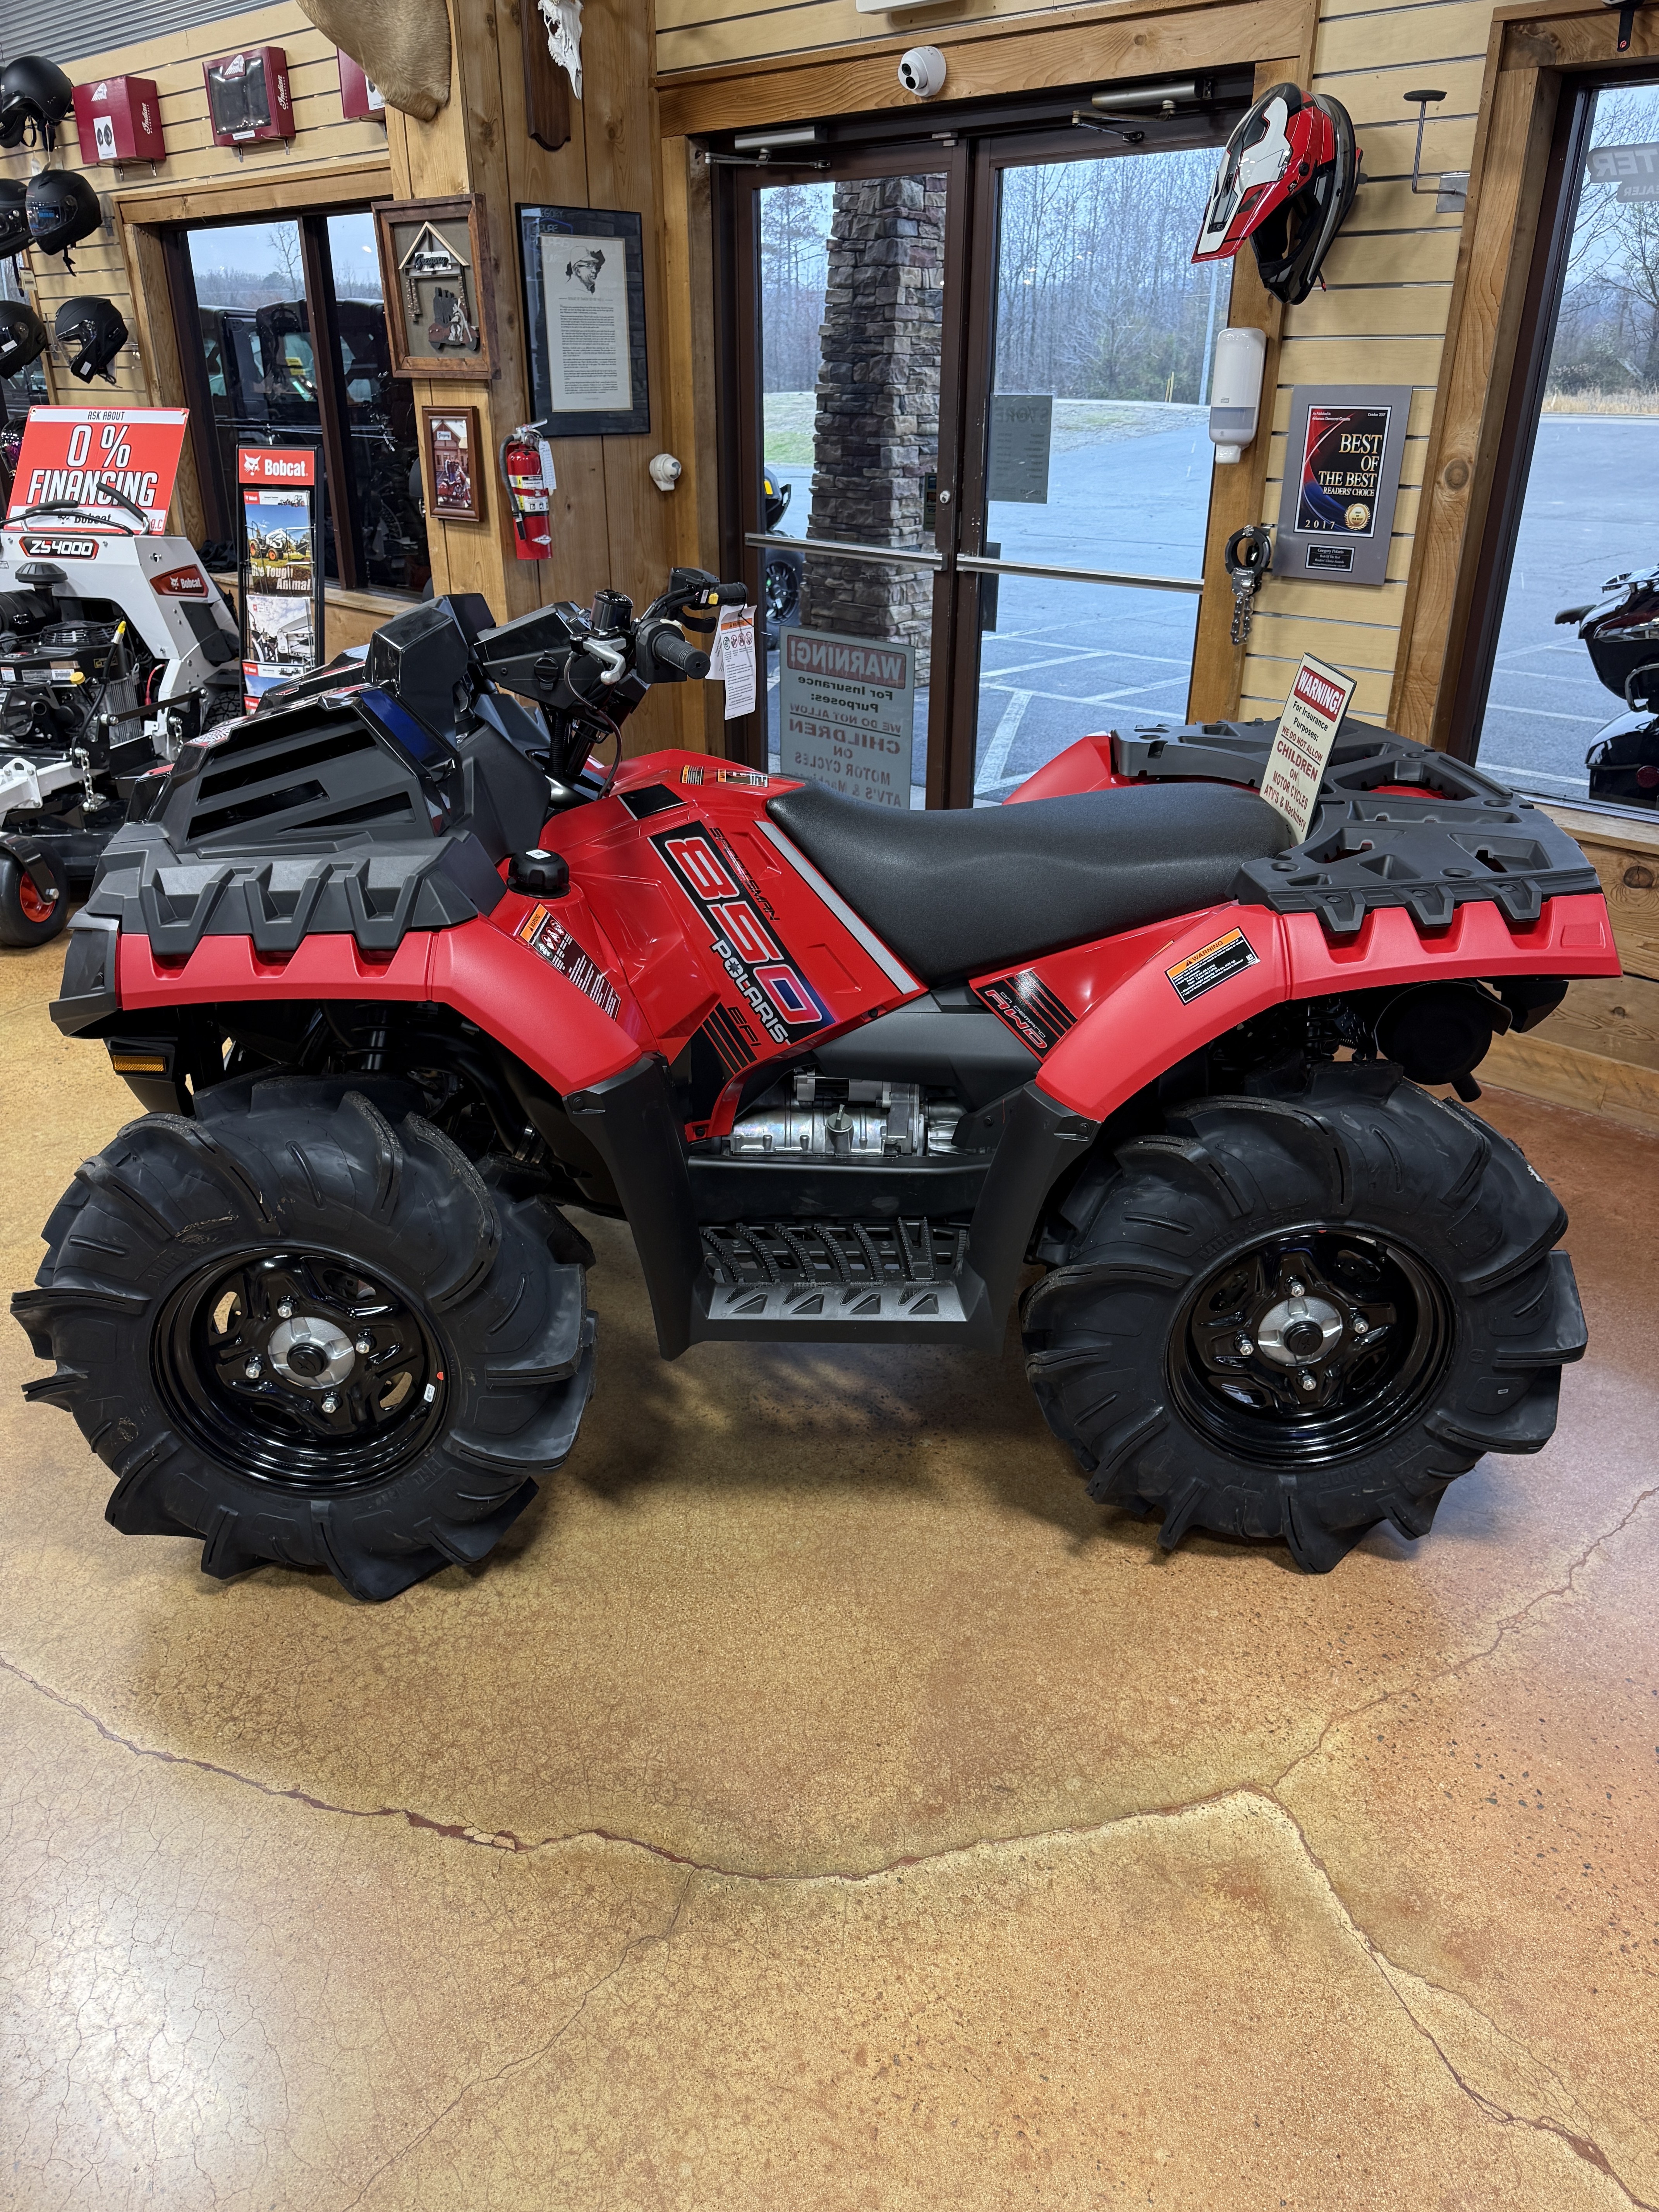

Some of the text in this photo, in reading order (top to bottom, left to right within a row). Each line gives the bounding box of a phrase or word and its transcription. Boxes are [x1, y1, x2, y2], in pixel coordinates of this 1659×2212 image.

[278, 74, 286, 110] Indian
[142, 103, 150, 134] Indian
[88, 411, 125, 421] ASK ABOUT
[67, 424, 93, 467] 0
[1338, 433, 1382, 454] BEST
[264, 459, 306, 477] Bobcat
[1318, 470, 1377, 488] THE BEST
[1361, 455, 1379, 472] OF
[26, 469, 159, 507] FINANCING
[1323, 487, 1375, 496] READERS' CHOICE
[1305, 519, 1336, 530] 2017
[29, 539, 94, 556] ZS4000
[180, 577, 203, 589] Bobcat
[266, 565, 294, 579] Tough
[1298, 670, 1343, 715] WARNING!
[1293, 701, 1328, 732] For Insurance
[1293, 717, 1319, 742] Purposes:
[1282, 725, 1323, 762] WE DO NOT ALLOW
[1277, 740, 1318, 782] CHILDREN
[1290, 768, 1298, 782] ON
[1273, 771, 1309, 810] MOTOR CYCLES
[1264, 784, 1279, 804] ATV'S
[1279, 797, 1284, 808] &
[1284, 800, 1307, 833] Machinery
[709, 827, 780, 921] SPORTSMAN
[665, 836, 822, 1025] 850
[1192, 940, 1224, 961] WARNING
[711, 939, 790, 1045] POLARIS
[726, 1006, 762, 1047] EFI
[984, 989, 1048, 1049] AWD
